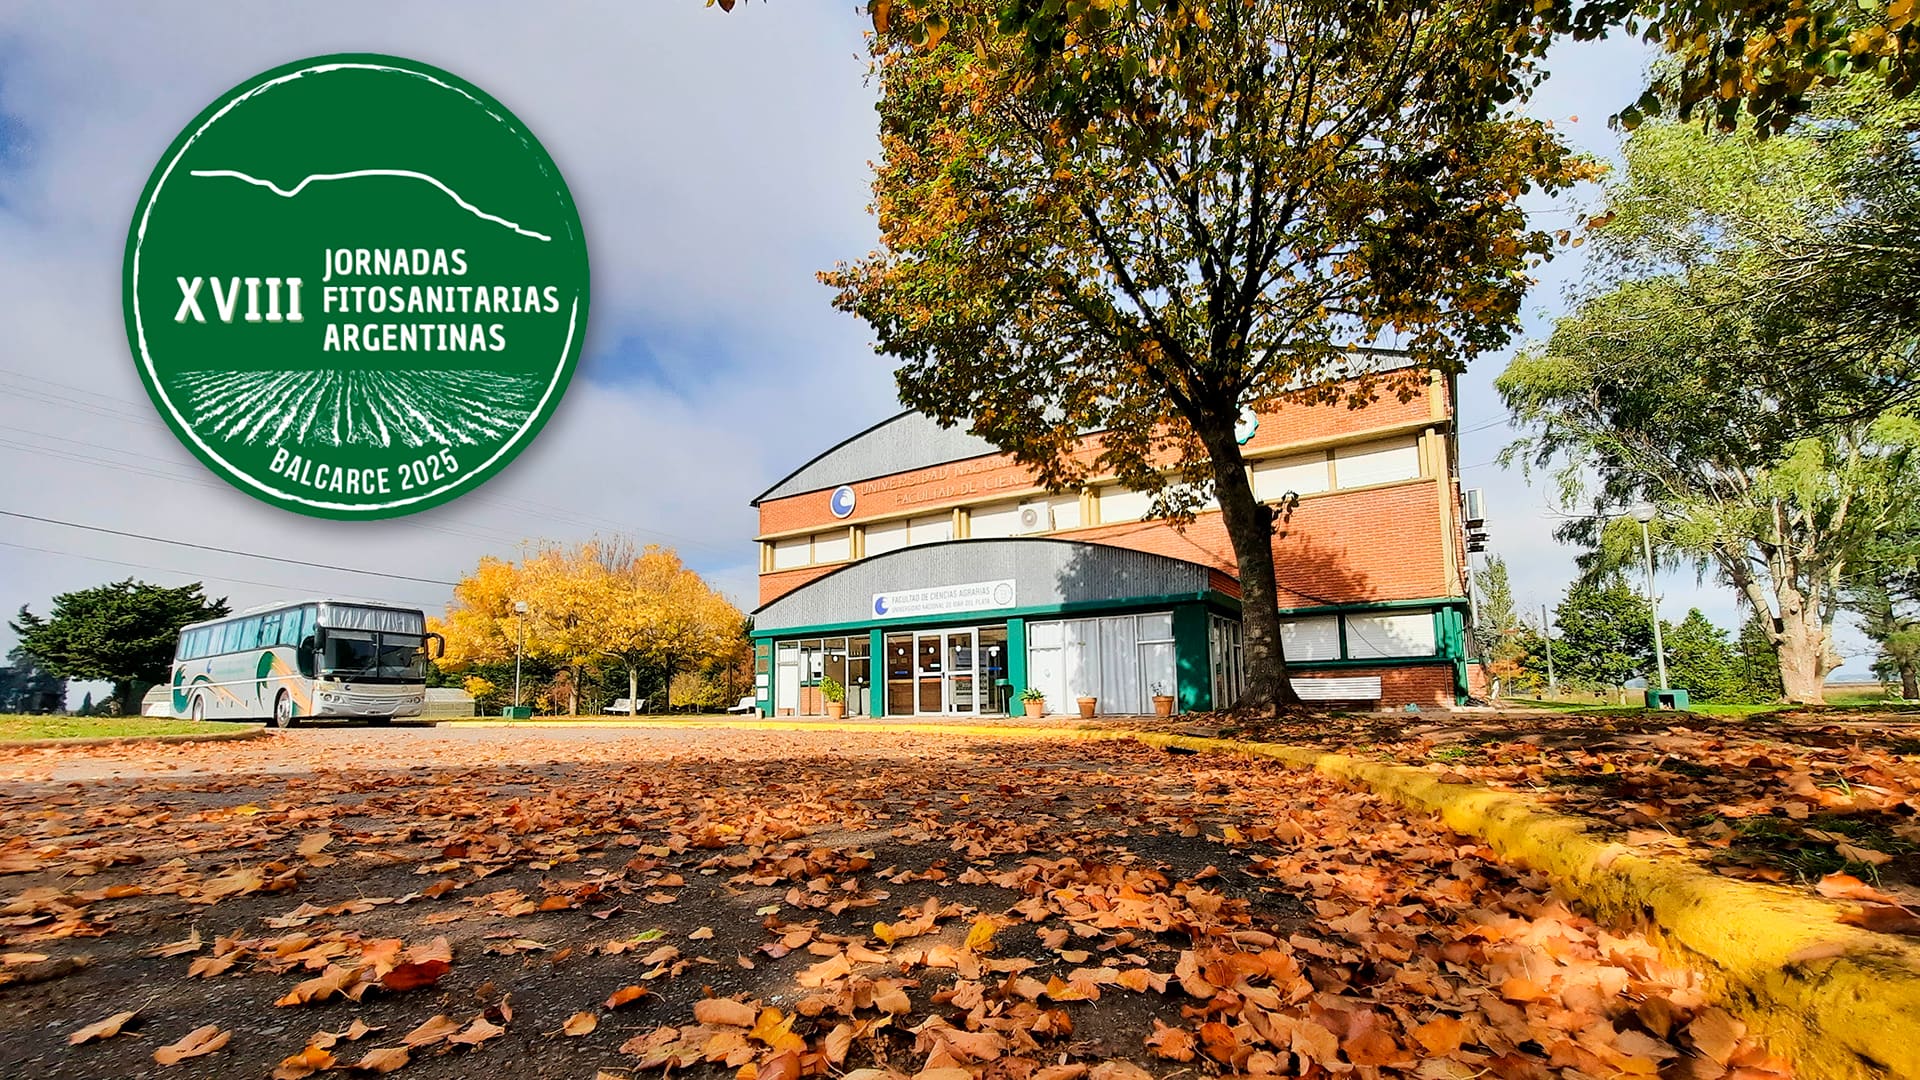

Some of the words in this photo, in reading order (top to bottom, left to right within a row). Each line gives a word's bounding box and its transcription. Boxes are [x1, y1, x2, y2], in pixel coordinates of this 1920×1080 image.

[861, 466, 947, 495] UNIVERSIDAD
[895, 485, 955, 504] FACULTAD
[960, 481, 977, 494] DE
[892, 593, 920, 604] FACULTAD
[921, 592, 929, 601] DE
[930, 589, 957, 601] CIENCIAS
[959, 586, 991, 598] AGRARIAS
